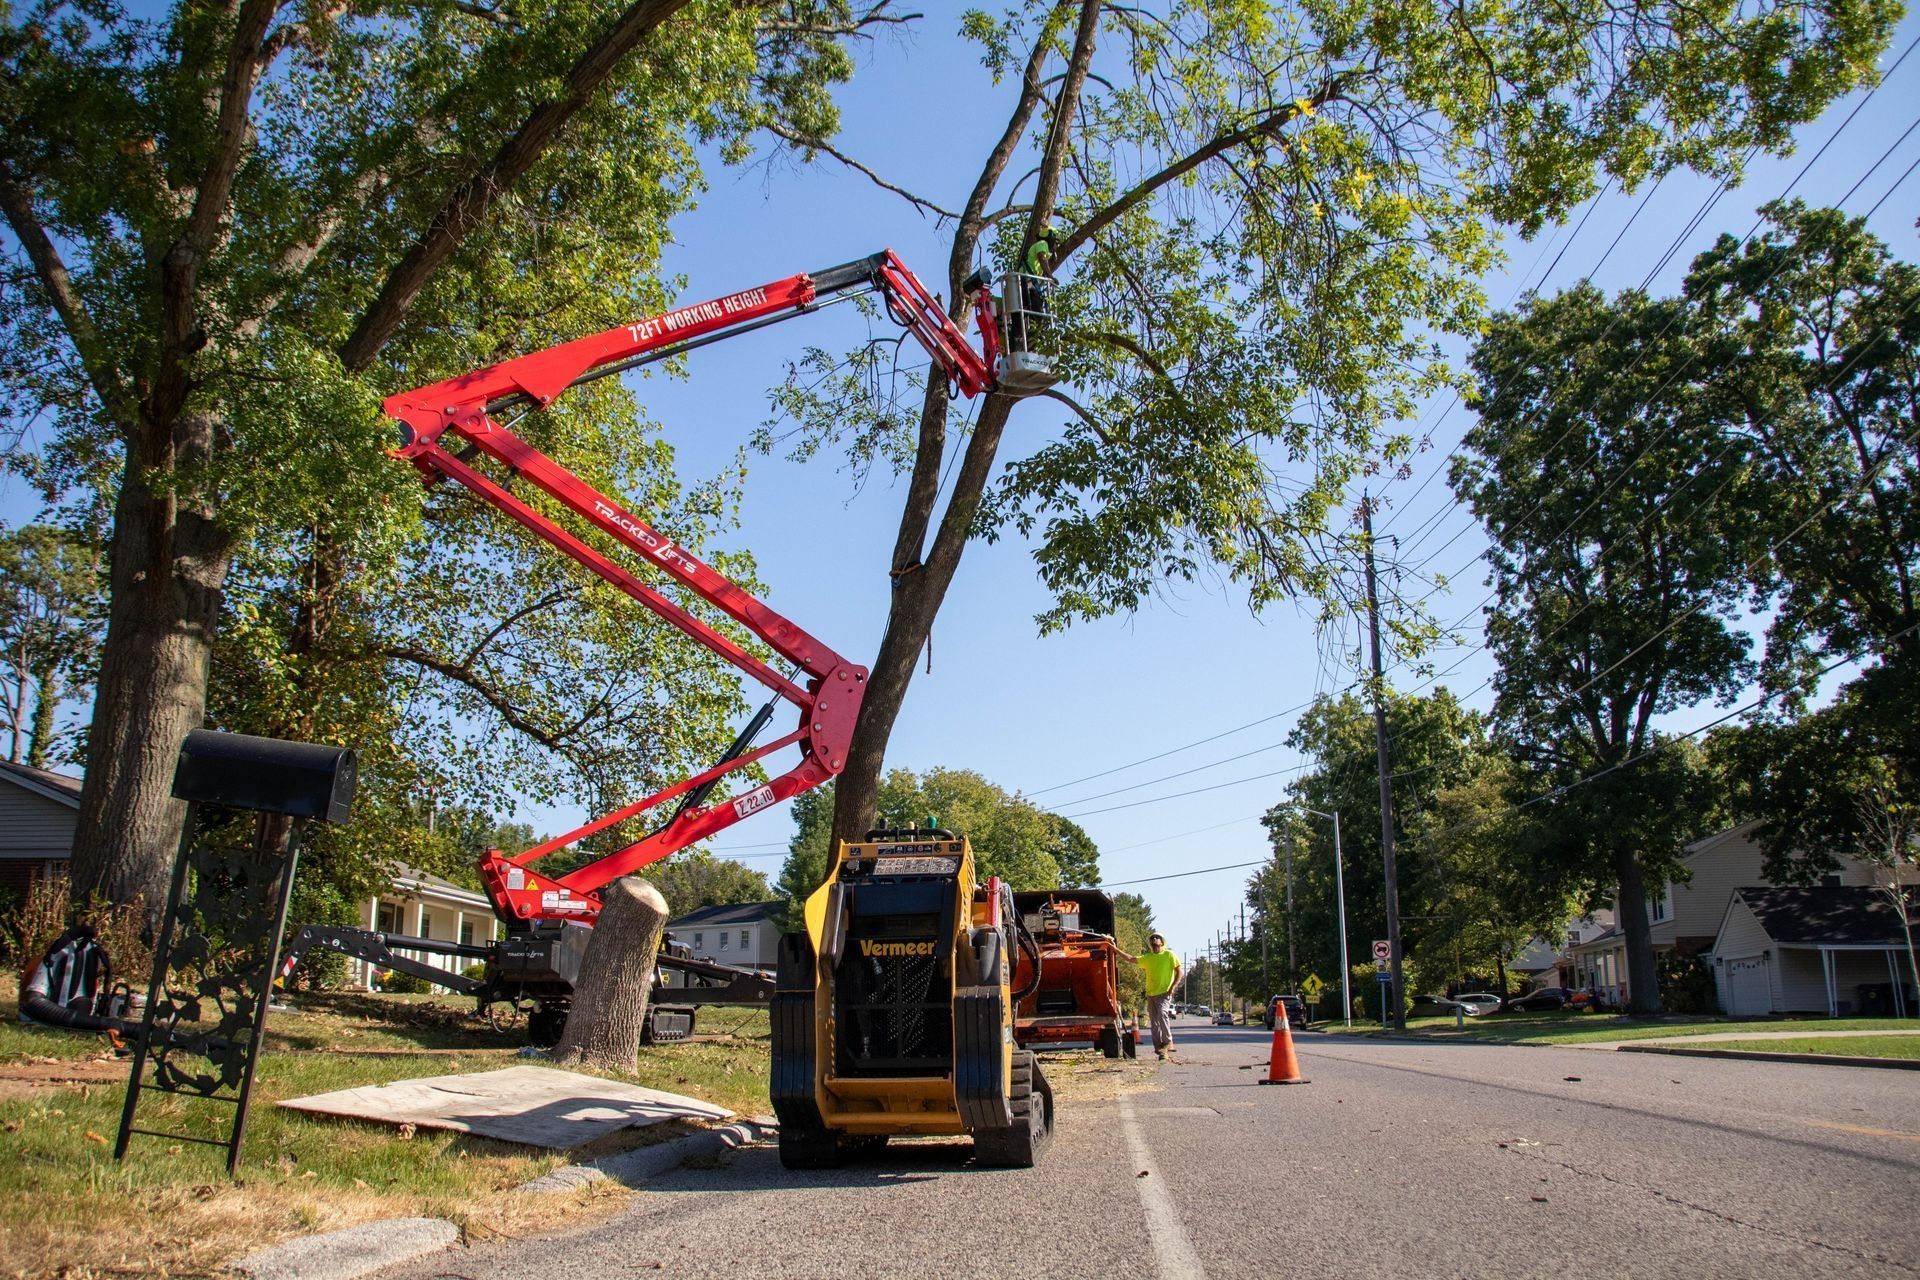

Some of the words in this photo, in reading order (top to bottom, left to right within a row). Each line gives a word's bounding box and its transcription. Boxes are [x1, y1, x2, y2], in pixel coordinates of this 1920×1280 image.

[628, 319, 662, 342] 72FT
[663, 301, 723, 332] WORKING
[722, 288, 768, 314] HEIGHT
[595, 500, 658, 548] TRACKED
[653, 541, 697, 574] LIFTS
[747, 789, 773, 810] 22.10
[860, 939, 935, 957] Vermeer
